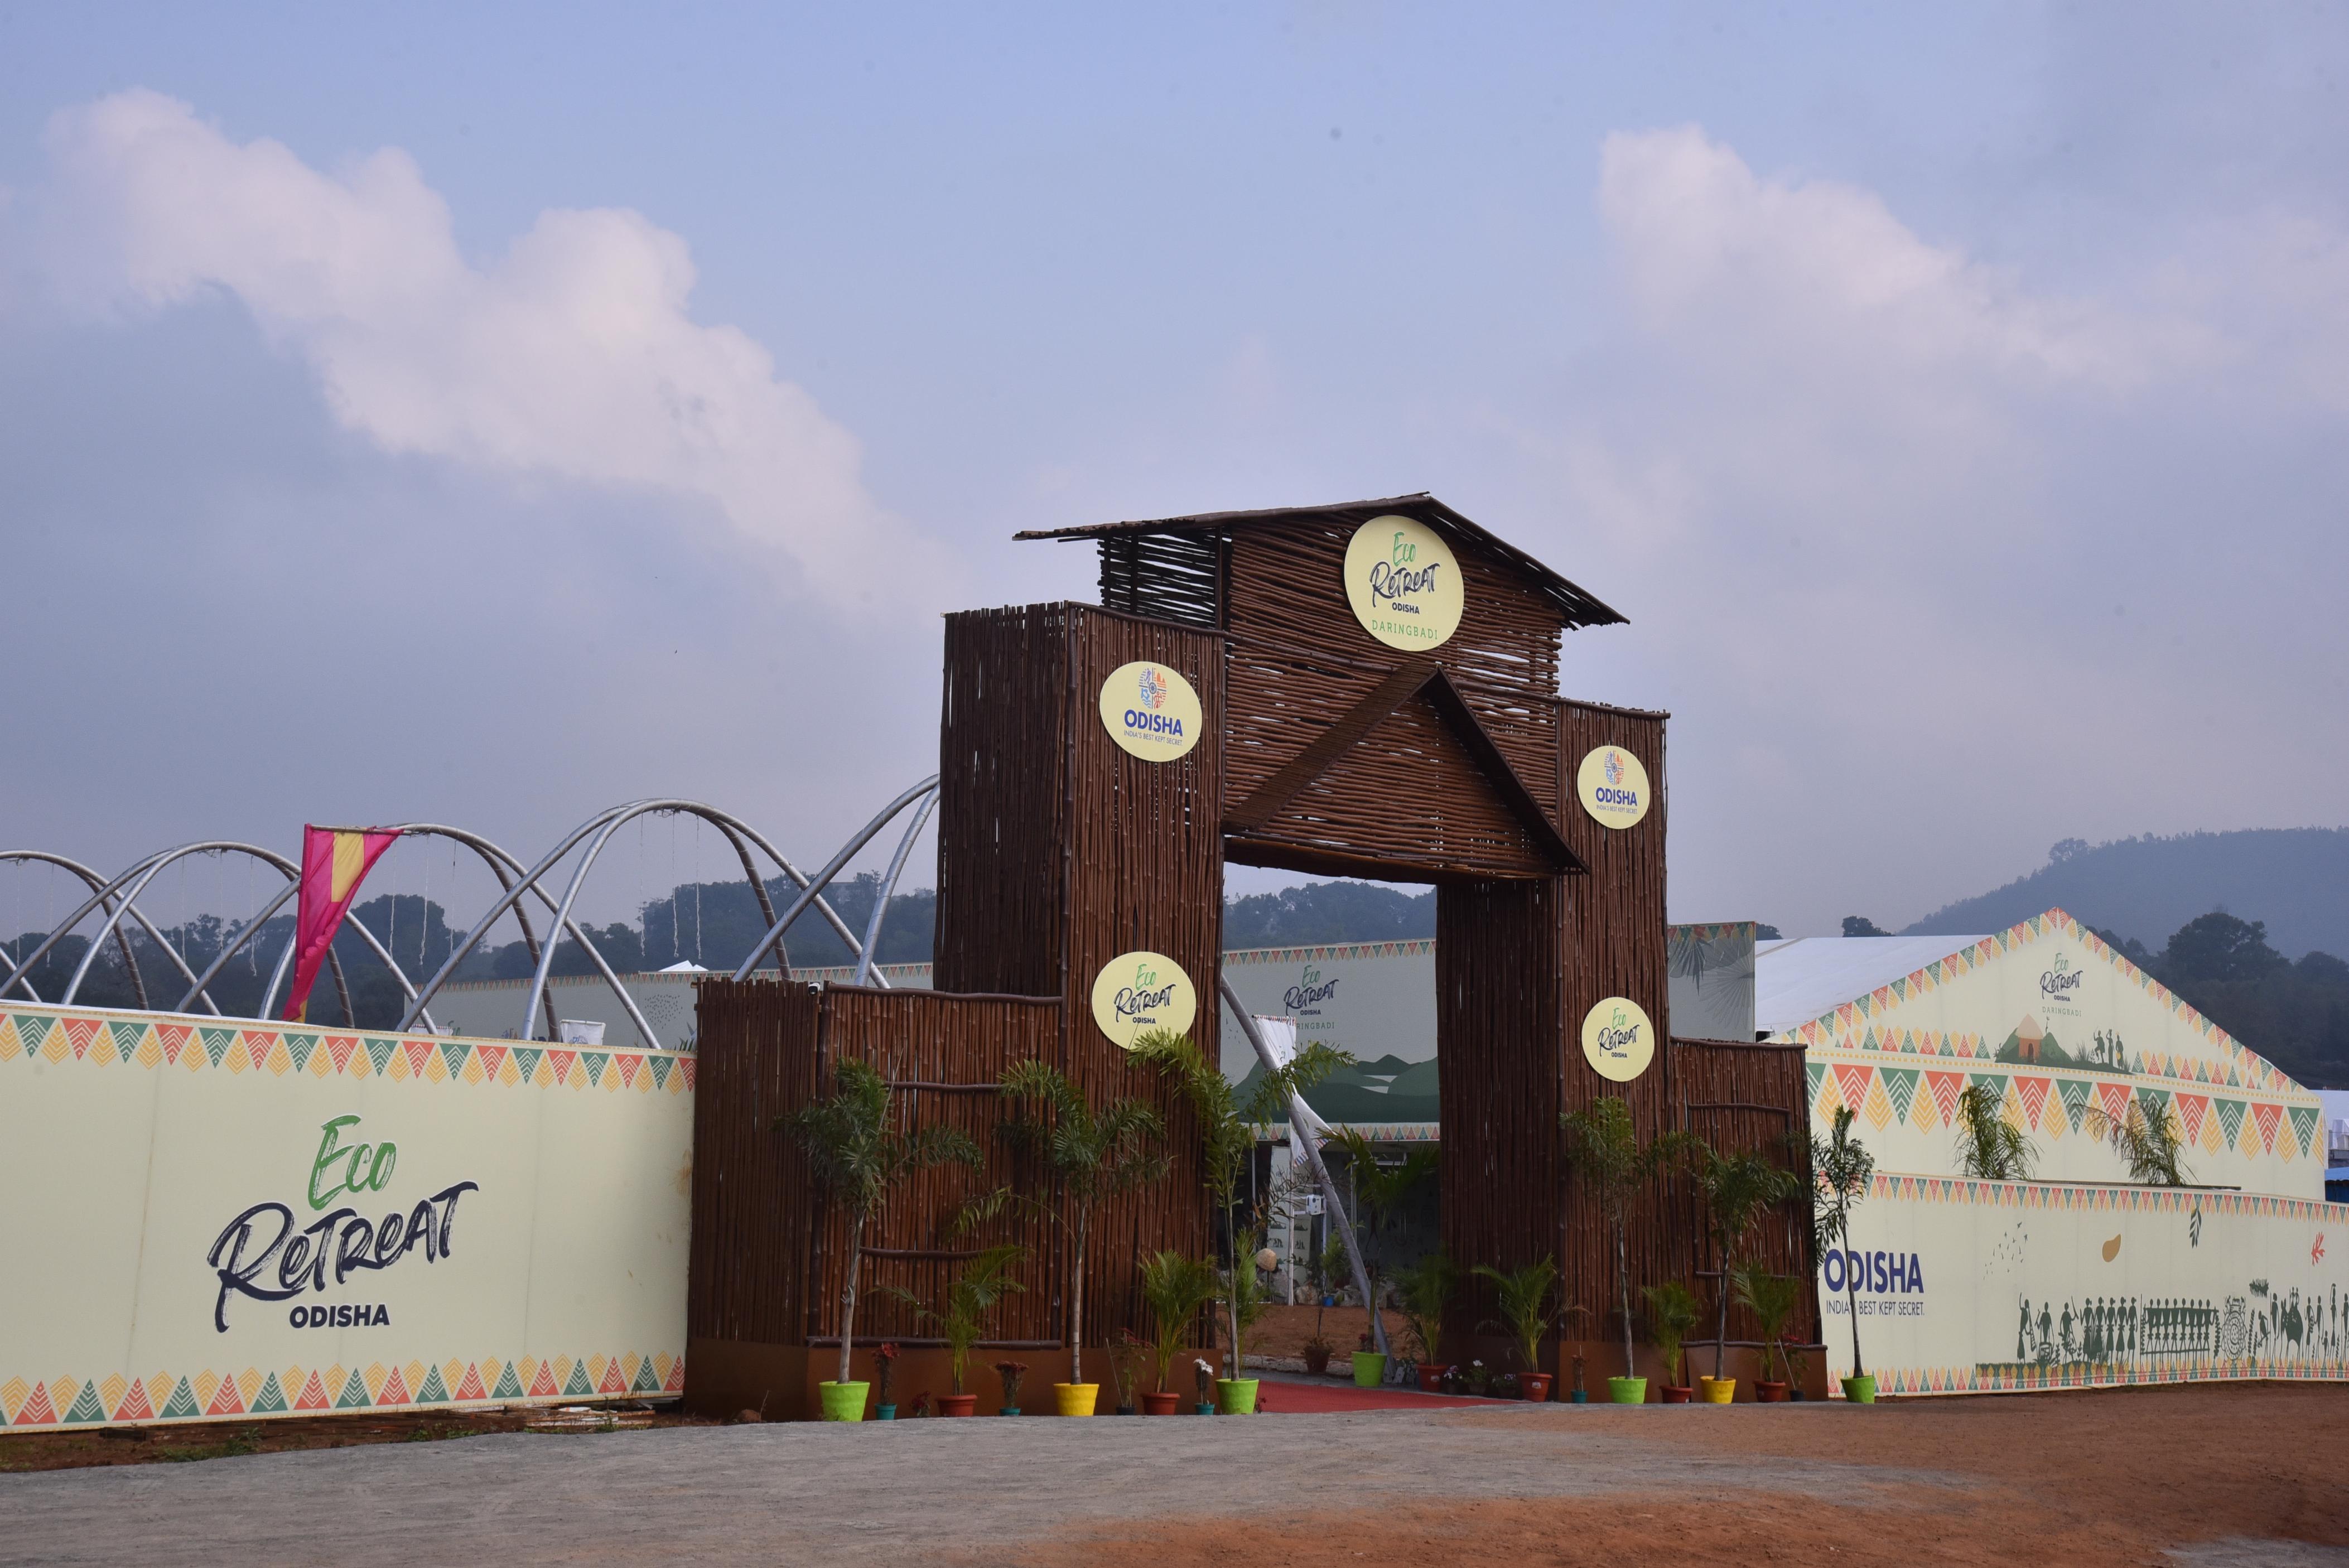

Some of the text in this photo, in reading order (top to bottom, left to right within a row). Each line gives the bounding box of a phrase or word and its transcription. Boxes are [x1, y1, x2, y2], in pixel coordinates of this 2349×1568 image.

[1392, 532, 1416, 567] Eco
[1392, 602, 1420, 614] ODISHA
[1372, 619, 1438, 640] DARINGBADI
[1124, 709, 1183, 737] ODISHA
[1123, 730, 1142, 739] INDIA'S
[1595, 787, 1638, 807] ODISHA
[2054, 952, 2069, 973] Eco
[1135, 963, 1157, 991] Eco
[1302, 964, 1320, 988] Eco
[1612, 1007, 1627, 1030] Eco
[2042, 1006, 2082, 1017] DARINGBADI
[1296, 1021, 1334, 1030] RINGBADI
[308, 1115, 397, 1210] Eco
[1824, 1248, 1924, 1294] ODISHA
[289, 1304, 390, 1329] ODISHA
[1826, 1300, 1856, 1315] INDIA
[1859, 1300, 1877, 1315] BEST
[1879, 1301, 1896, 1315] KEPT
